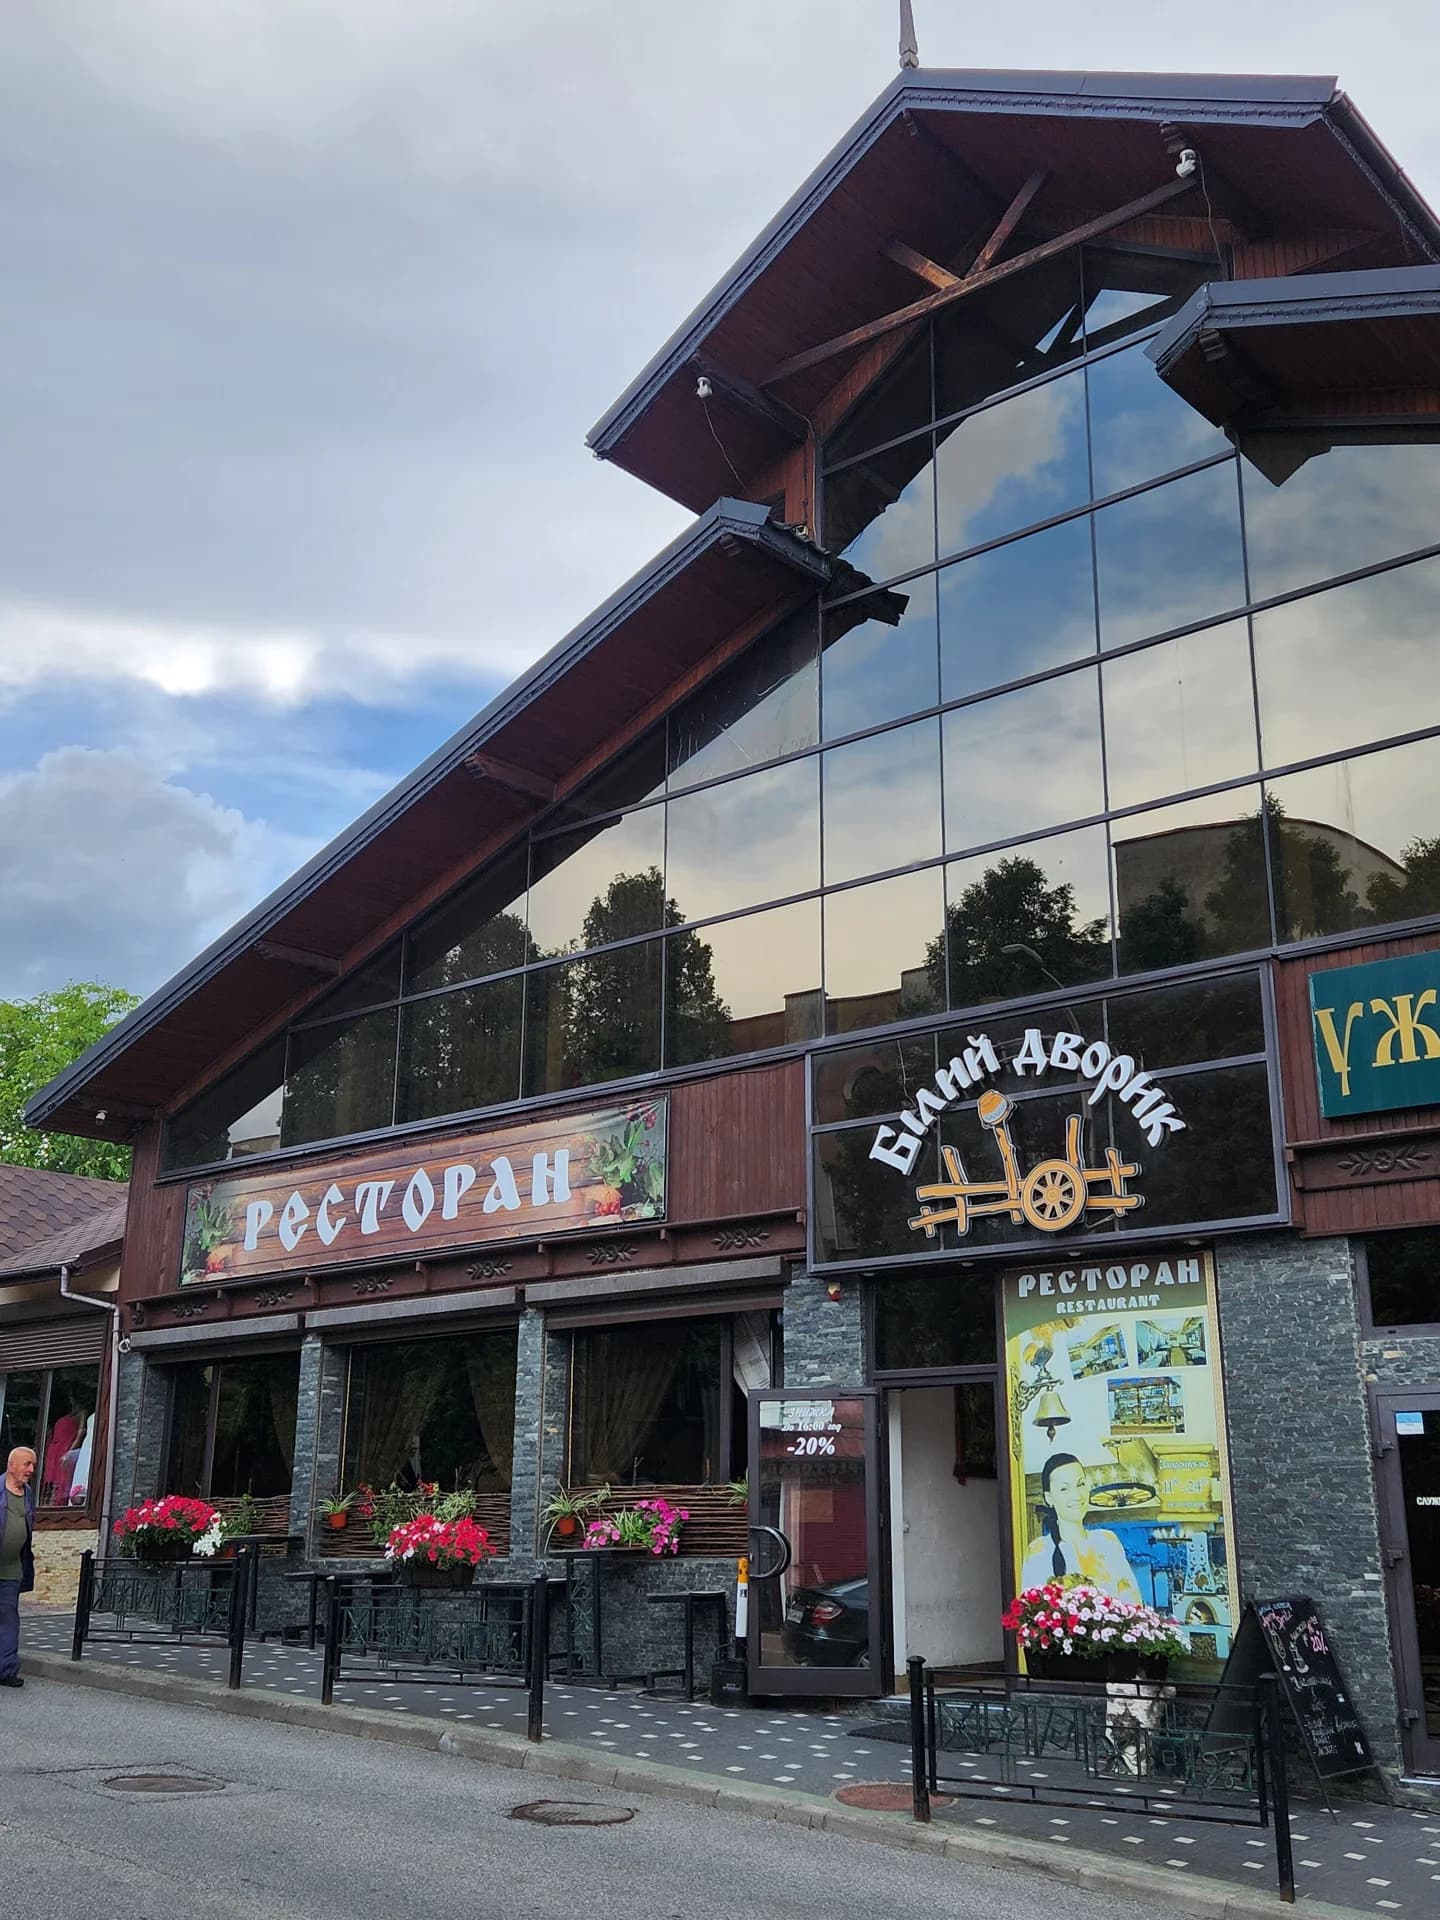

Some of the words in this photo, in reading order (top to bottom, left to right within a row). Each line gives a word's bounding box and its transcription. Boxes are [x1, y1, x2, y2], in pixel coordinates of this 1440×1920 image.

[868, 1033, 1001, 1176] БІЛИЙ
[1012, 1028, 1187, 1148] ДВОРИК
[242, 1148, 571, 1253] РЕСТОРАН
[1018, 1258, 1200, 1298] РЕСТОРАН
[1056, 1294, 1160, 1314] RESTAURANT
[797, 1421, 825, 1432] 16:00
[786, 1436, 836, 1455] -20%
